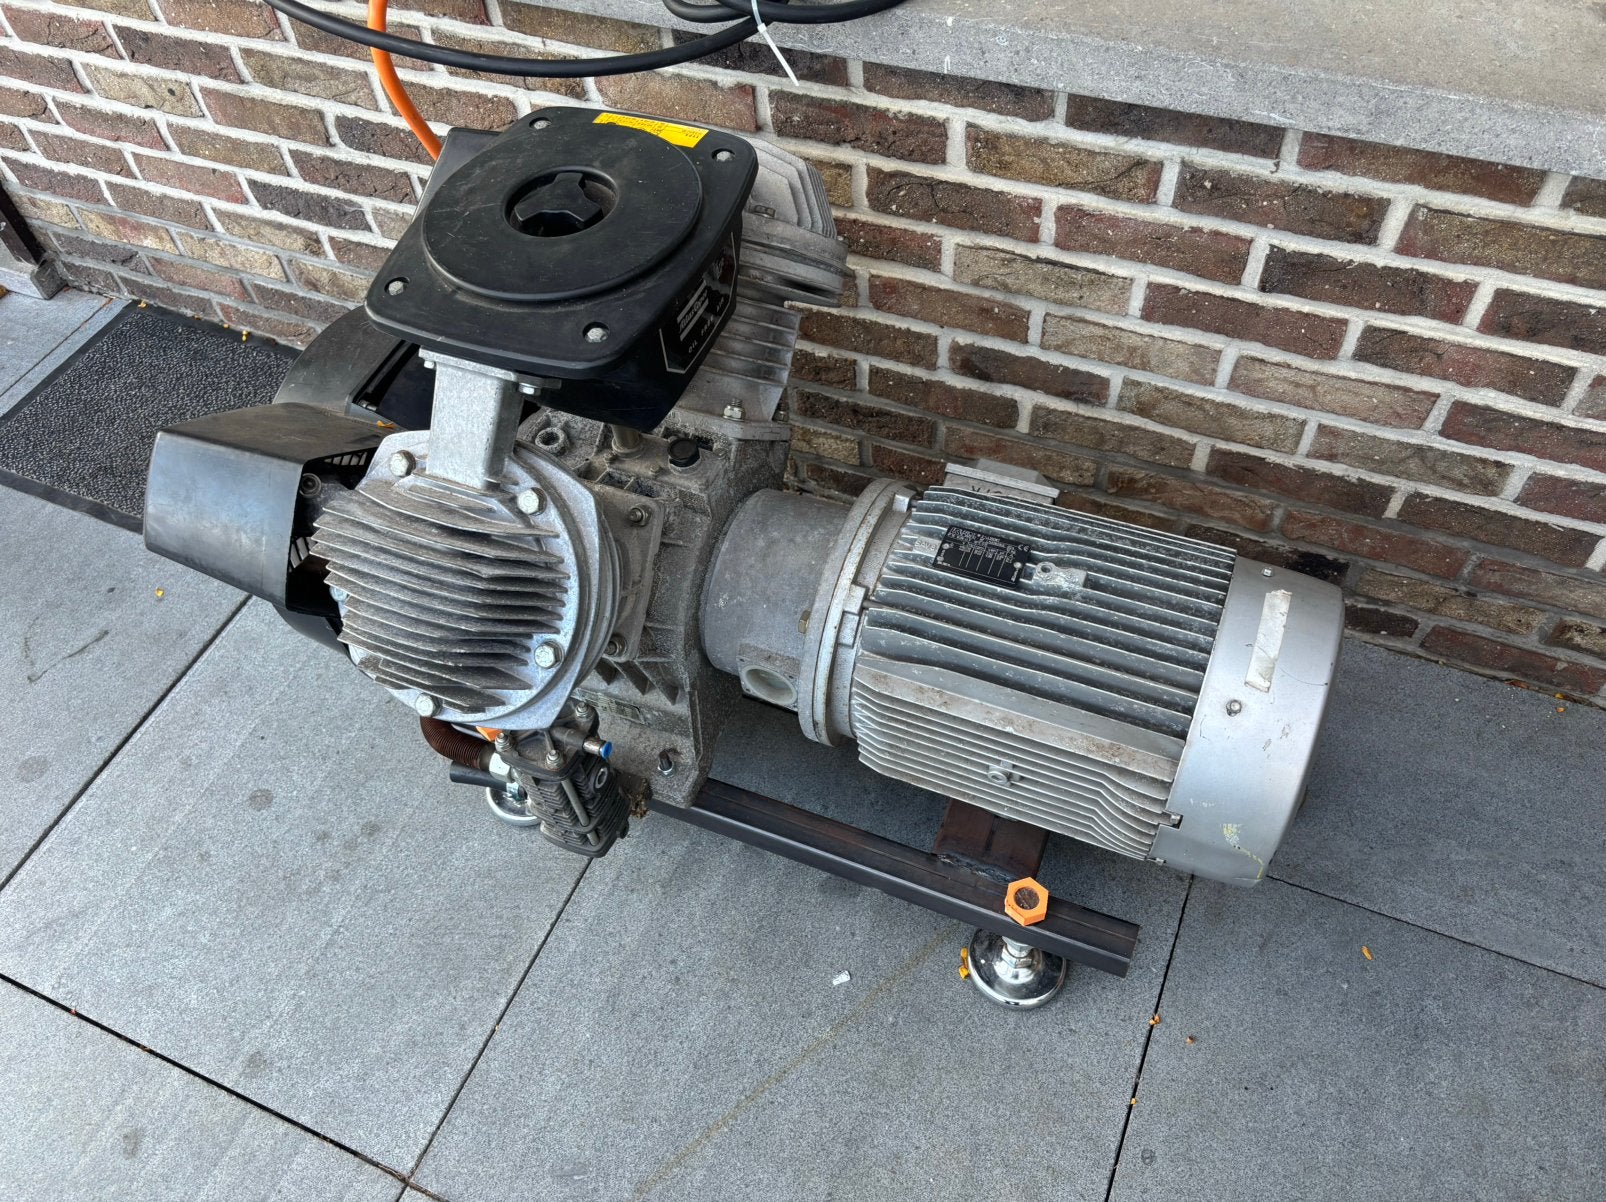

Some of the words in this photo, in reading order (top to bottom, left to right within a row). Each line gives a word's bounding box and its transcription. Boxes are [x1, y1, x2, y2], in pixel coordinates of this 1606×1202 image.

[688, 340, 698, 353] OIL
[701, 314, 714, 337] FREE
[716, 297, 724, 312] AIR
